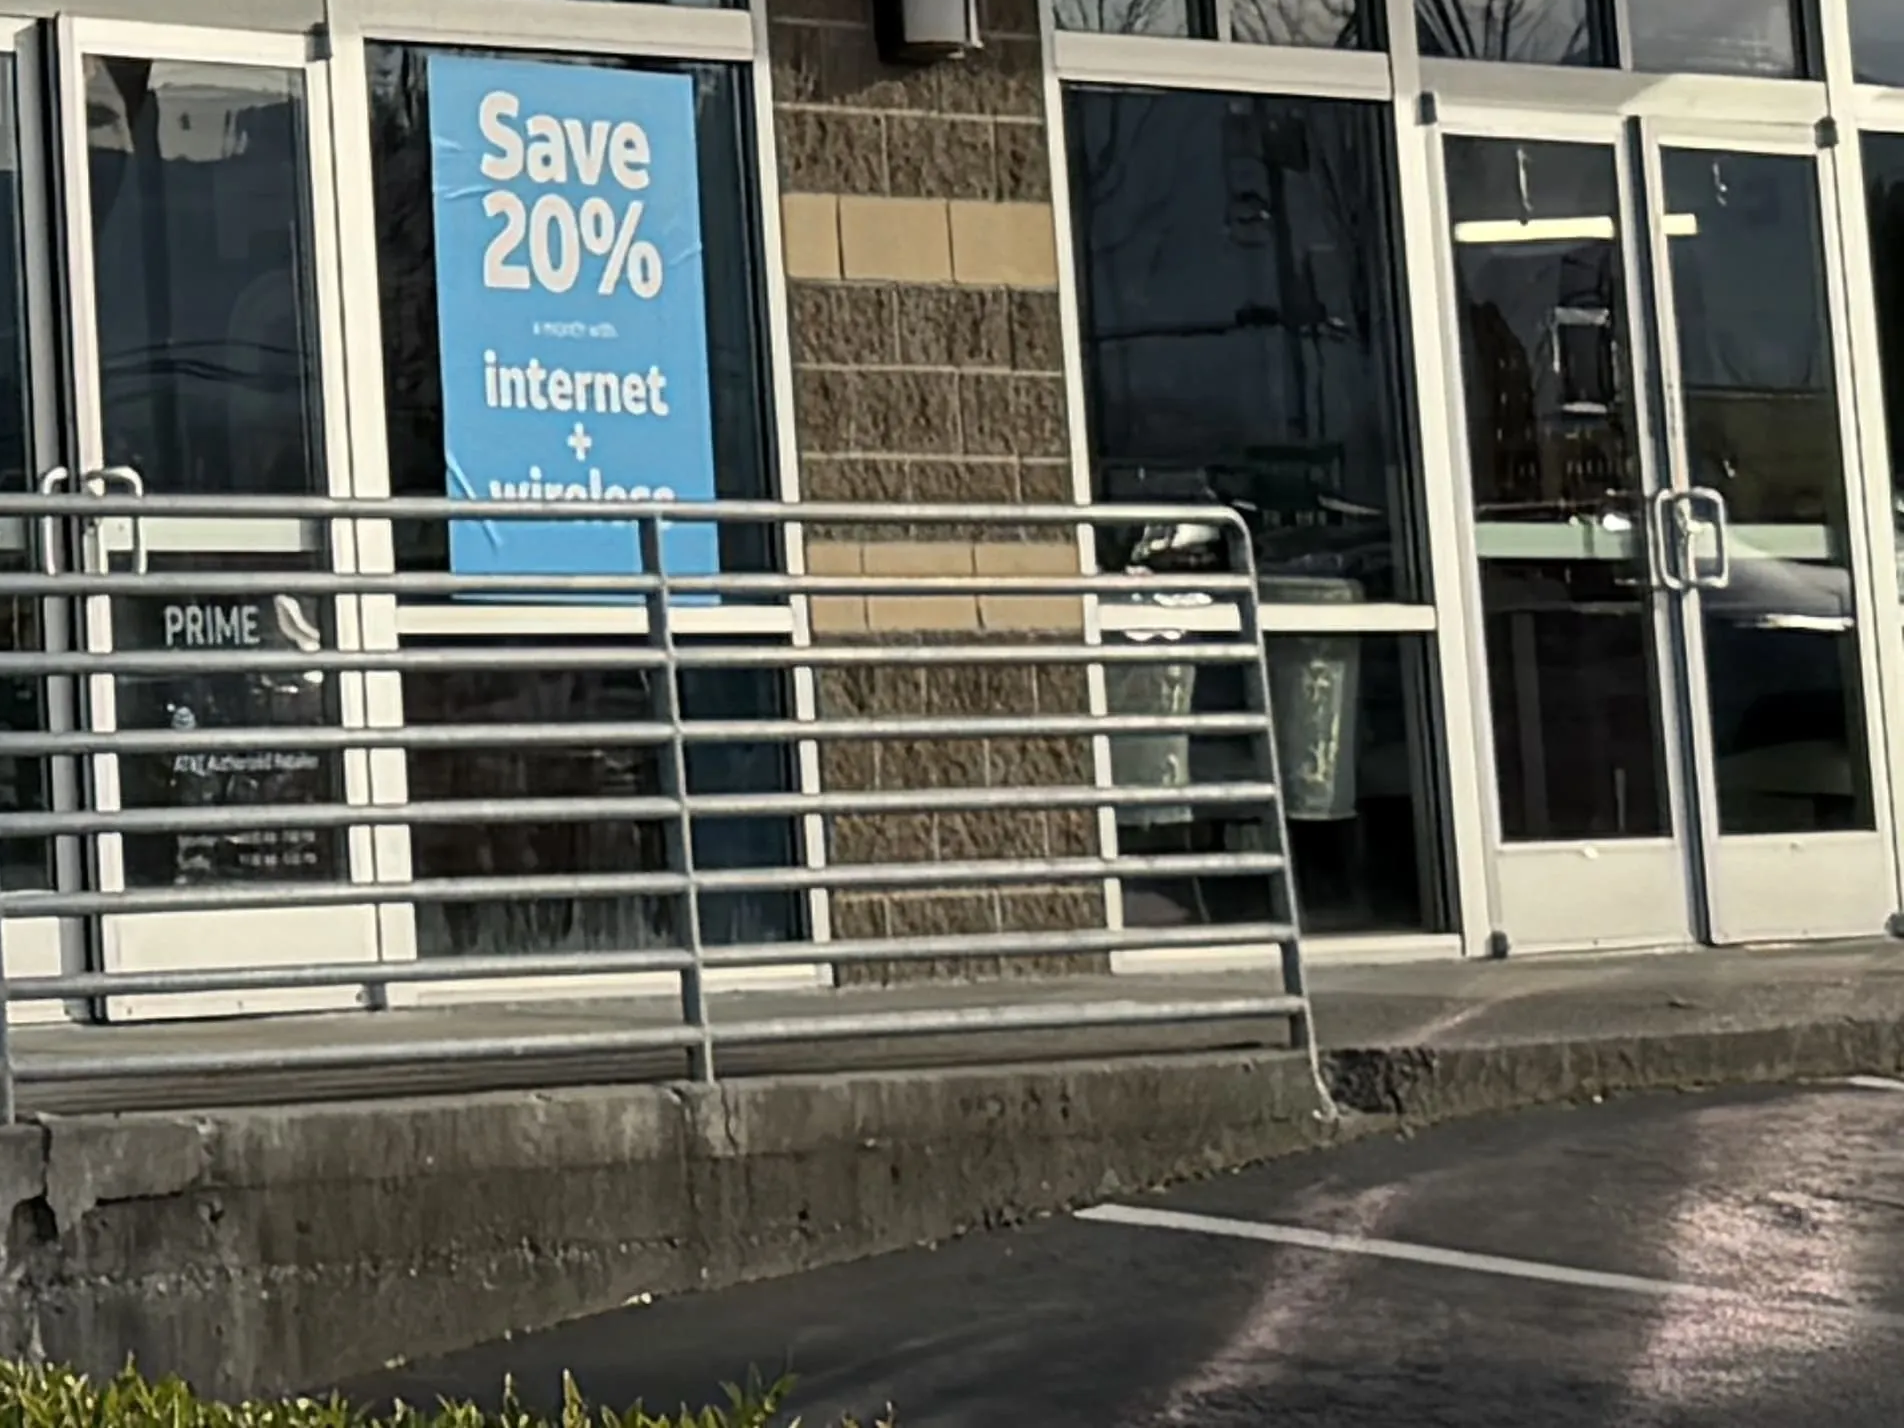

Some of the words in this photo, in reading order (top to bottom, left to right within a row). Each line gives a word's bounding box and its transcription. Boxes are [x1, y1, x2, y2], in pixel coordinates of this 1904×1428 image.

[478, 89, 652, 190] Save
[482, 191, 663, 299] 20%
[484, 349, 670, 416] internet
[164, 605, 260, 646] PRIME
